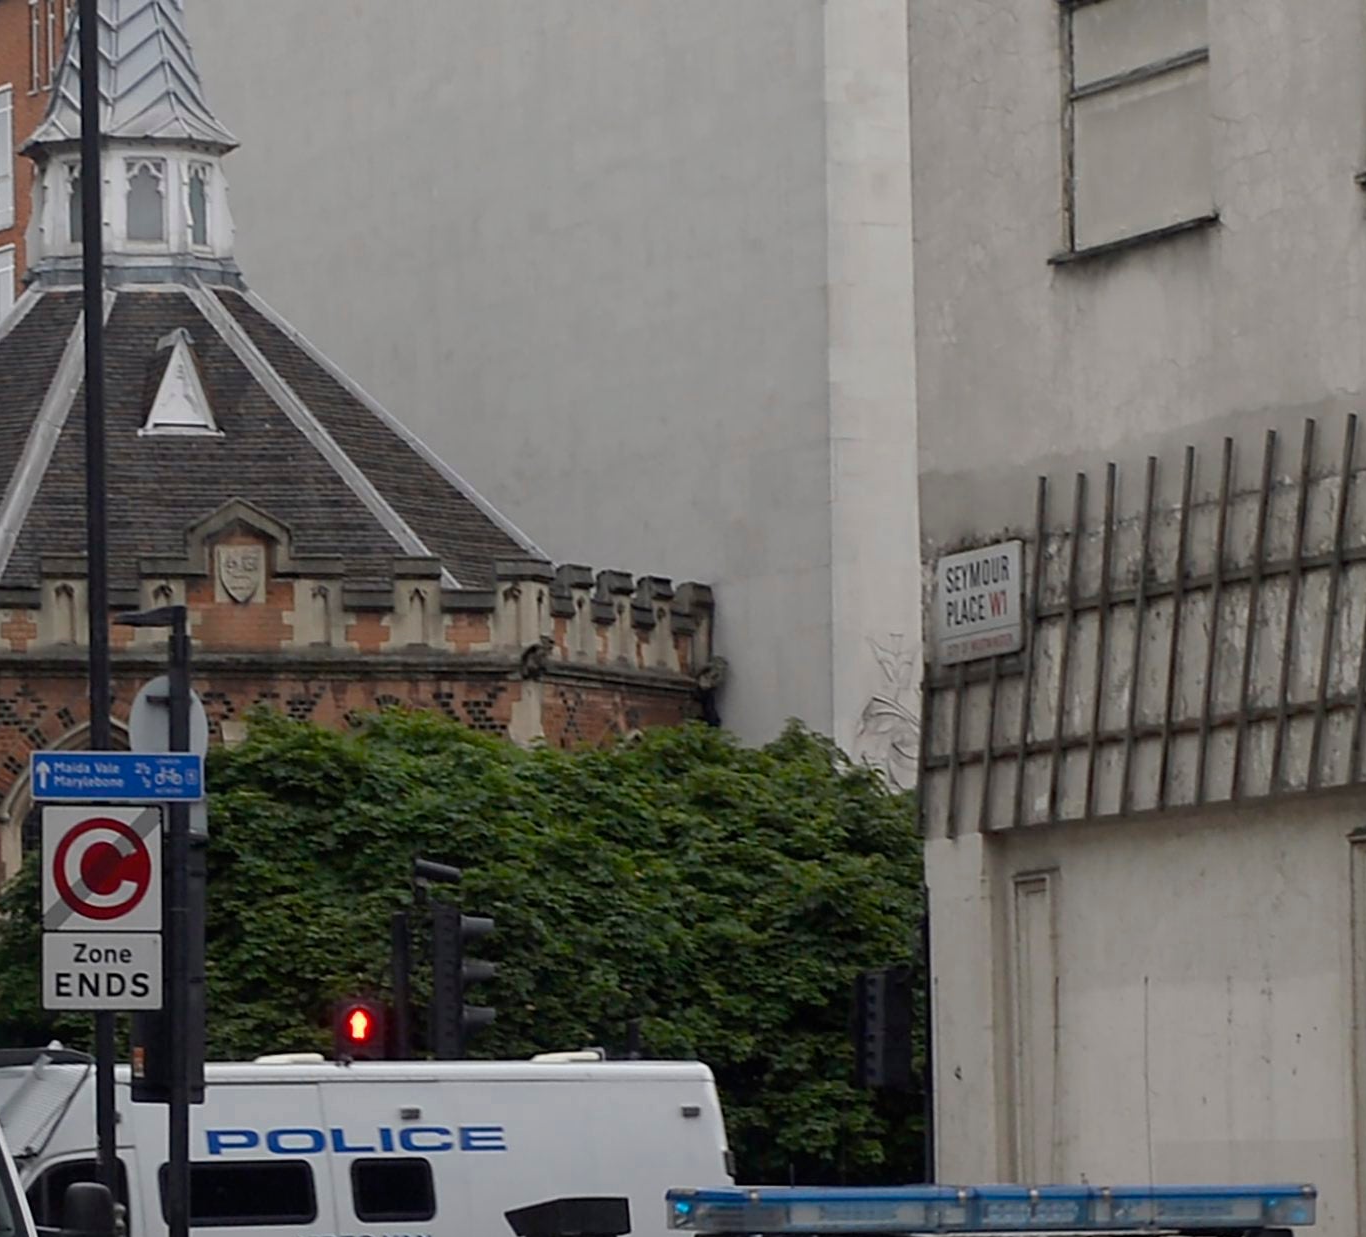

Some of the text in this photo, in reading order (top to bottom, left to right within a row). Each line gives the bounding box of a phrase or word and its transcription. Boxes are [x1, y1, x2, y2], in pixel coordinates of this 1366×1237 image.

[945, 555, 1010, 594] SEYMOUR
[946, 590, 1007, 628] PLACE W1
[53, 761, 91, 774] Maida
[95, 763, 120, 774] Vale
[53, 776, 124, 788] Marylebone
[73, 944, 132, 964] Zone
[55, 972, 150, 998] ENDS
[206, 1126, 507, 1155] POLICE
